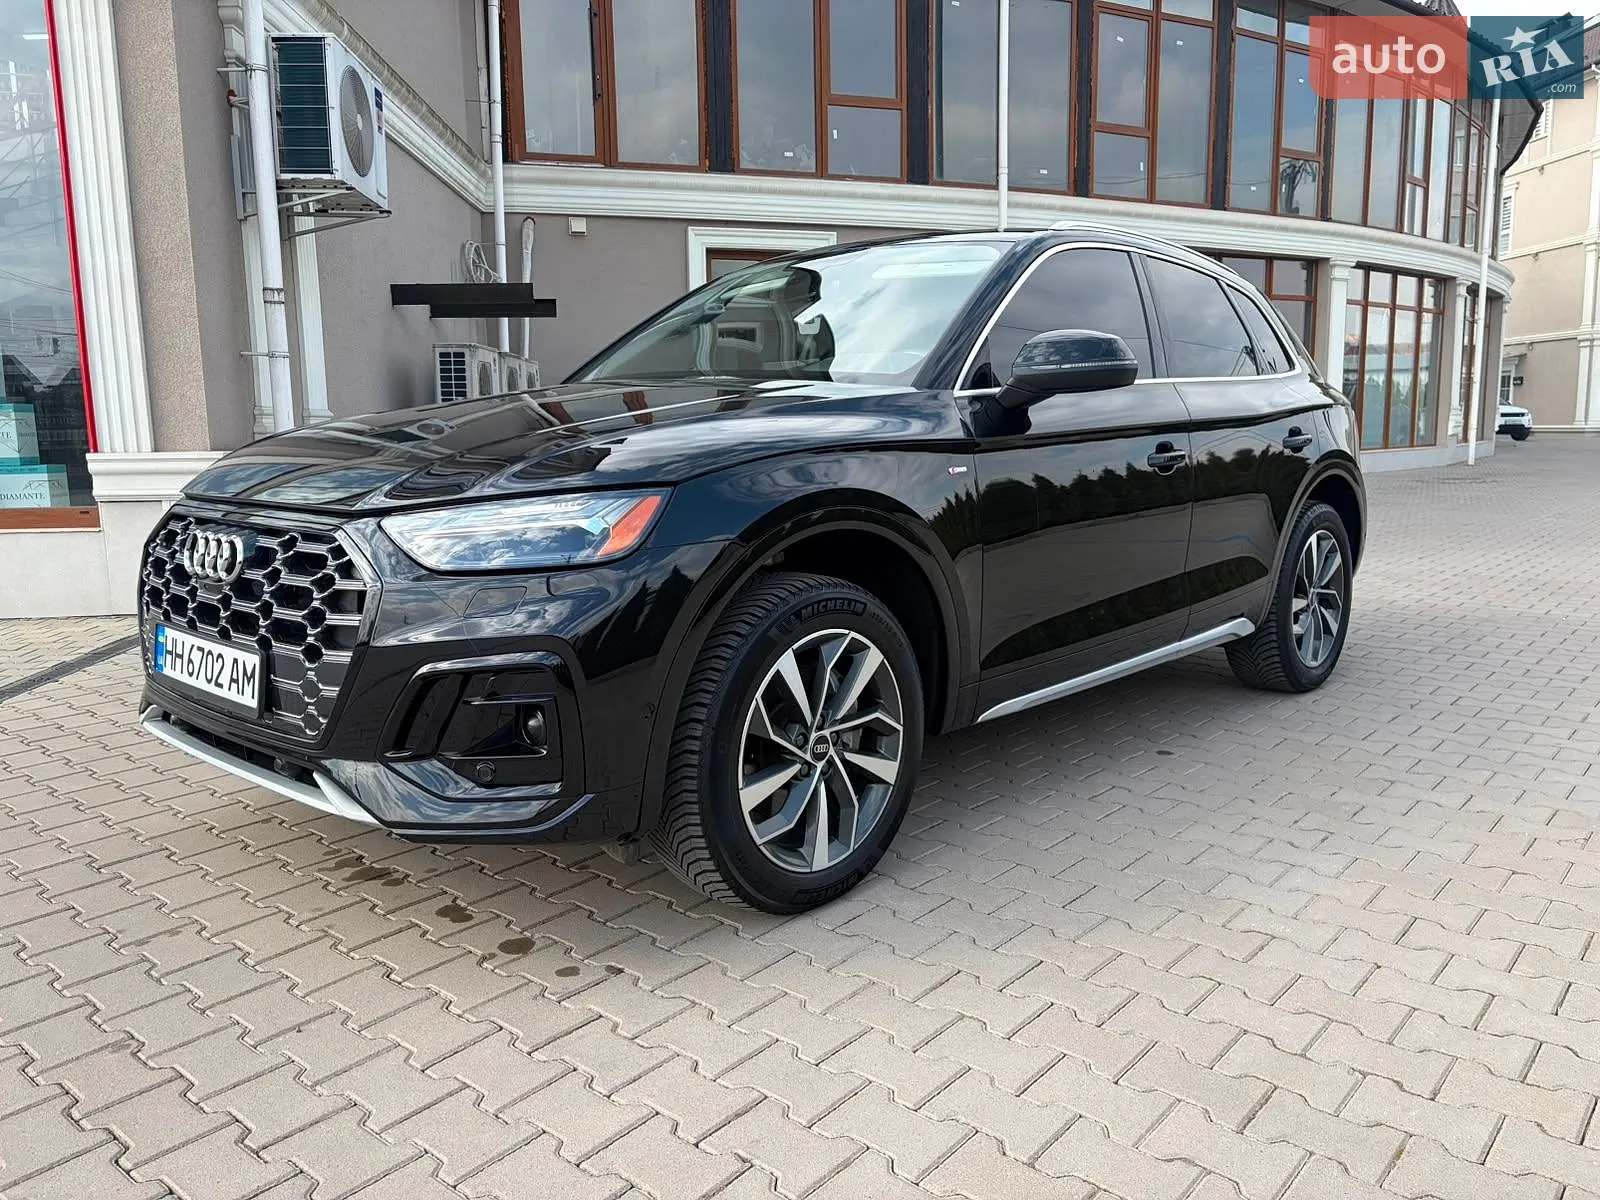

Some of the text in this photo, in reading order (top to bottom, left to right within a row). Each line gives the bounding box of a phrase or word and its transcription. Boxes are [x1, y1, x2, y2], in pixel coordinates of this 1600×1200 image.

[801, 599, 865, 620] MICHELIN
[187, 644, 224, 689] 6702
[228, 657, 256, 700] AM
